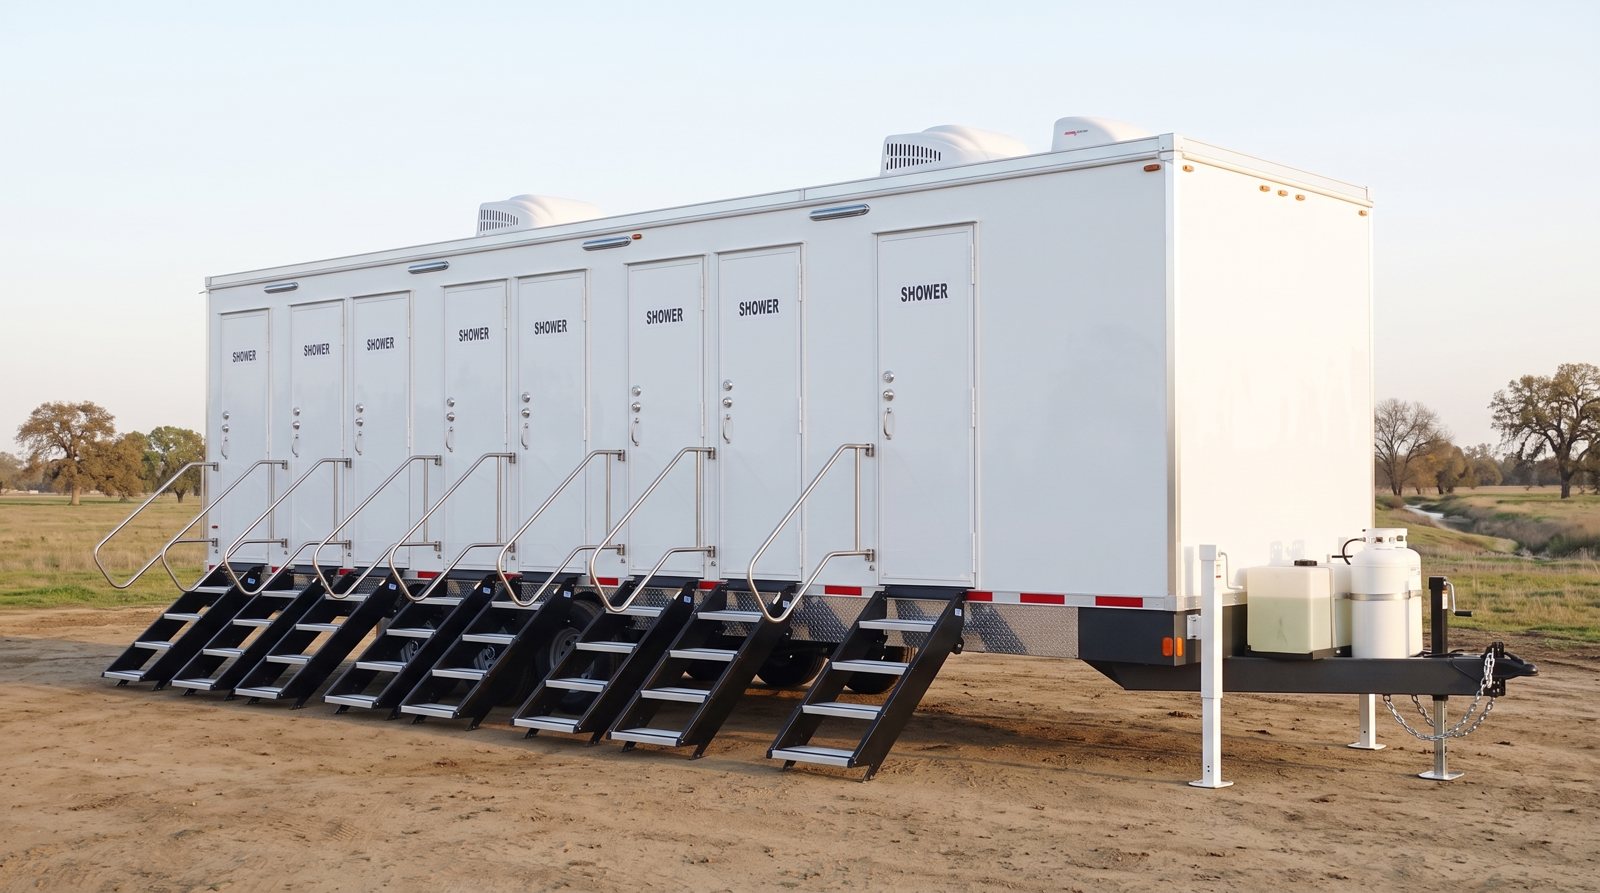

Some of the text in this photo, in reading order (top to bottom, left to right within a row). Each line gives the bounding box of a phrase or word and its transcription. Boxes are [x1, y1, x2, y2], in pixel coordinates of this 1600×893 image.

[900, 283, 948, 302] SHOWER
[739, 298, 779, 316] SHOWER
[646, 307, 683, 324] SHOWER
[459, 326, 489, 342] SHOWER
[535, 320, 567, 335] SHOWER
[304, 343, 330, 357] SHOWER
[367, 337, 394, 351] SHOWER
[233, 350, 256, 363] SHOWER
